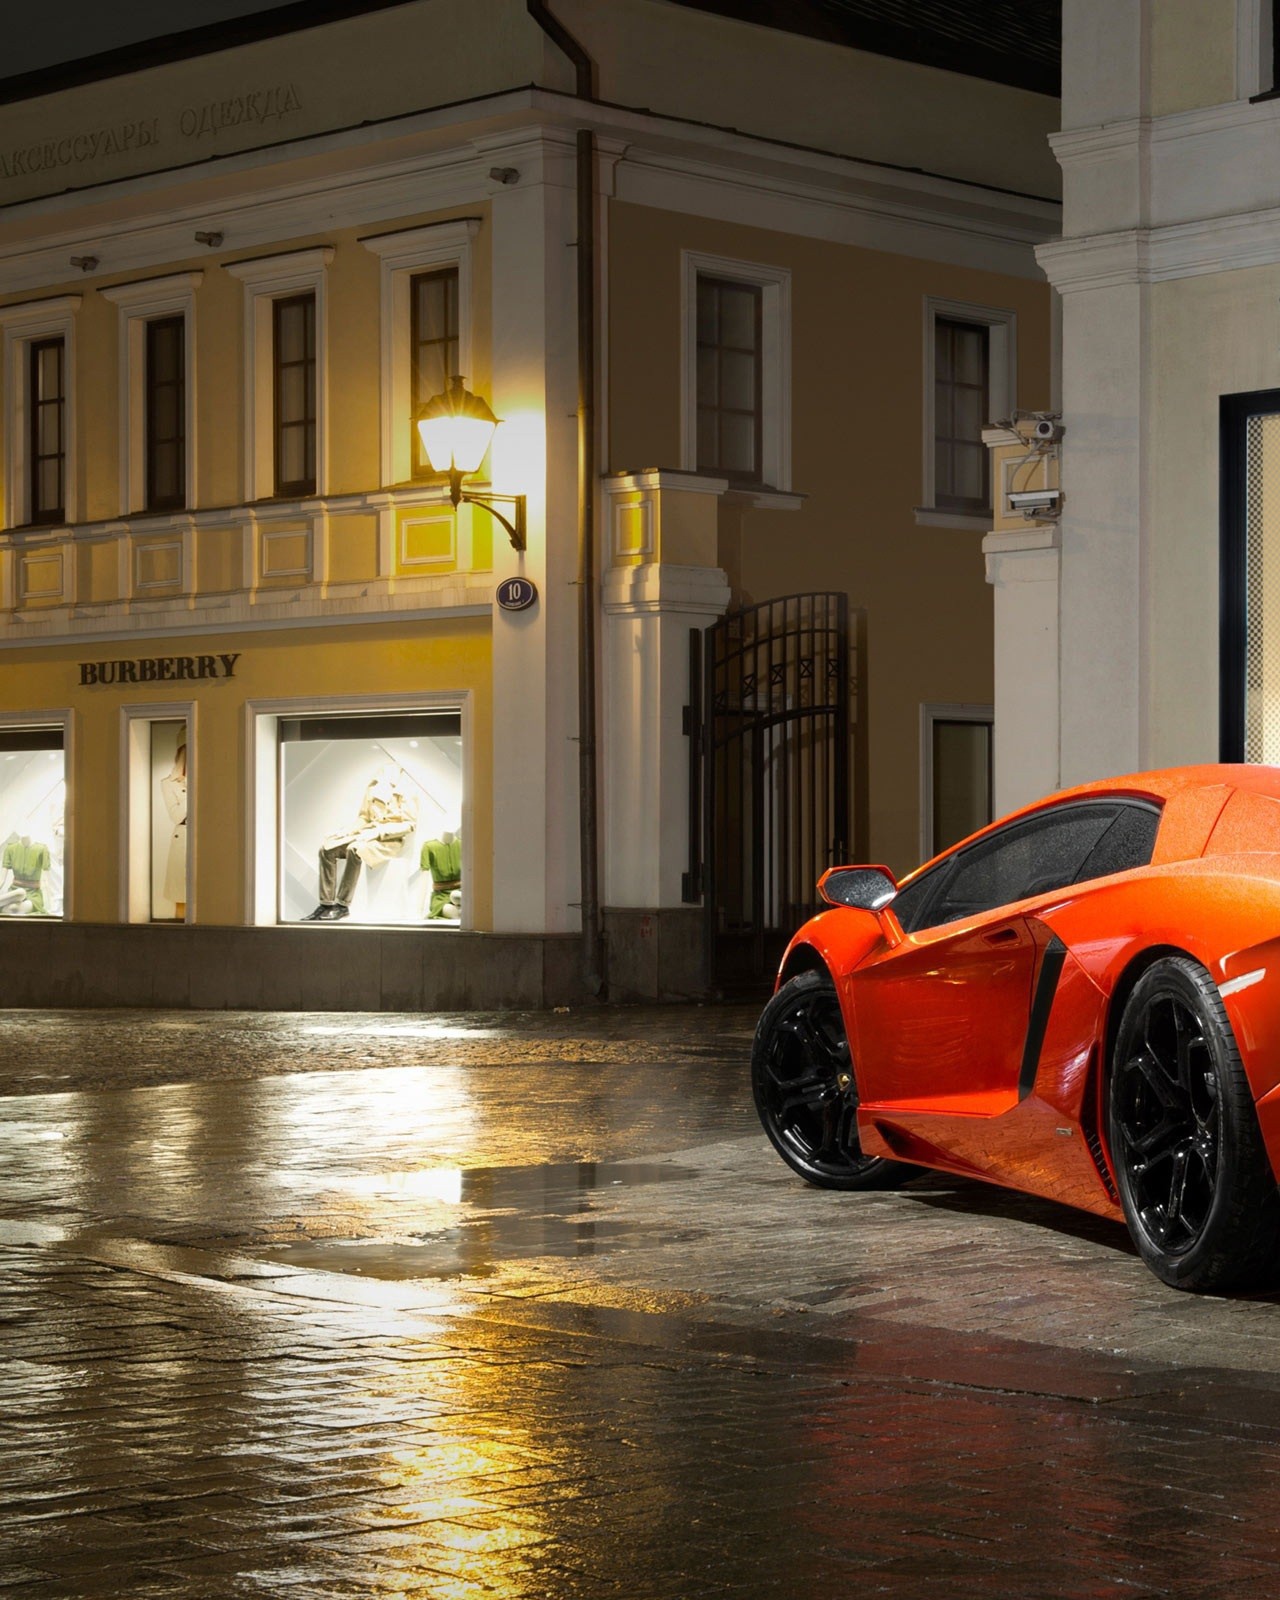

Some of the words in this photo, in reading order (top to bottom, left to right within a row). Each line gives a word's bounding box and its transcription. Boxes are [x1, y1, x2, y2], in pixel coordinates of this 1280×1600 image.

[180, 83, 303, 138] ОДЕЖДА
[508, 583, 521, 601] 10
[78, 653, 241, 686] BURBERRY
